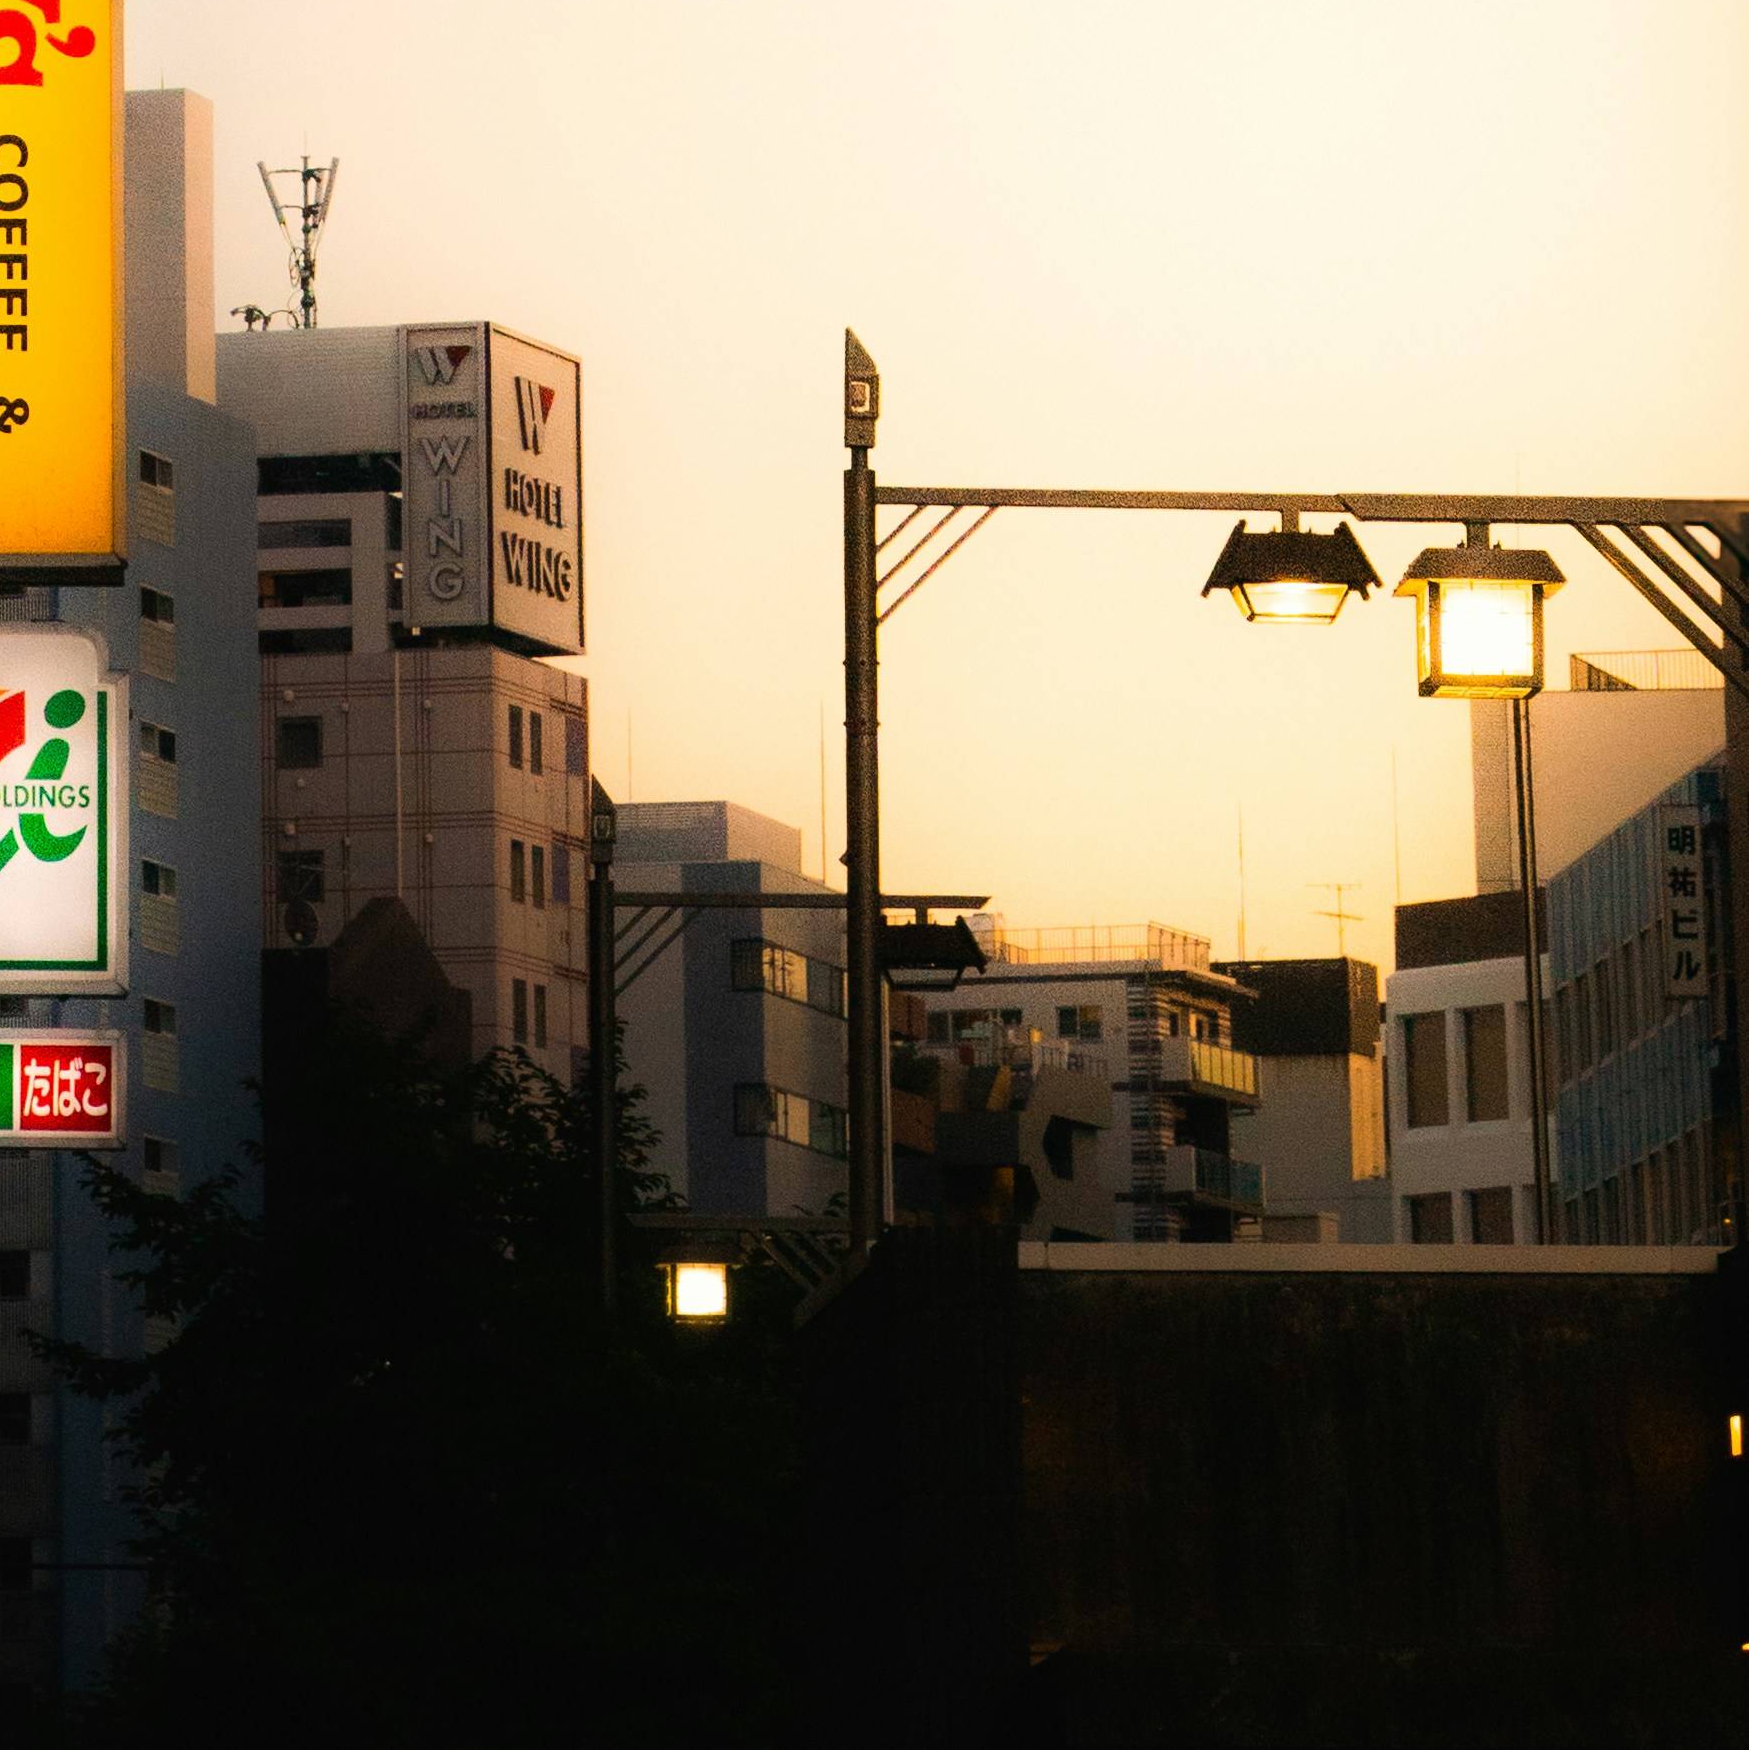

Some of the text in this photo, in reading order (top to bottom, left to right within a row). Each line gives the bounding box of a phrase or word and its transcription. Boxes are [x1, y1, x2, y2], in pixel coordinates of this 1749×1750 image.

[410, 401, 478, 420] HOTEL
[418, 435, 470, 601] WING
[504, 467, 564, 529] HOTEL
[500, 531, 572, 602] WING
[23, 1058, 108, 1117] たばこ
